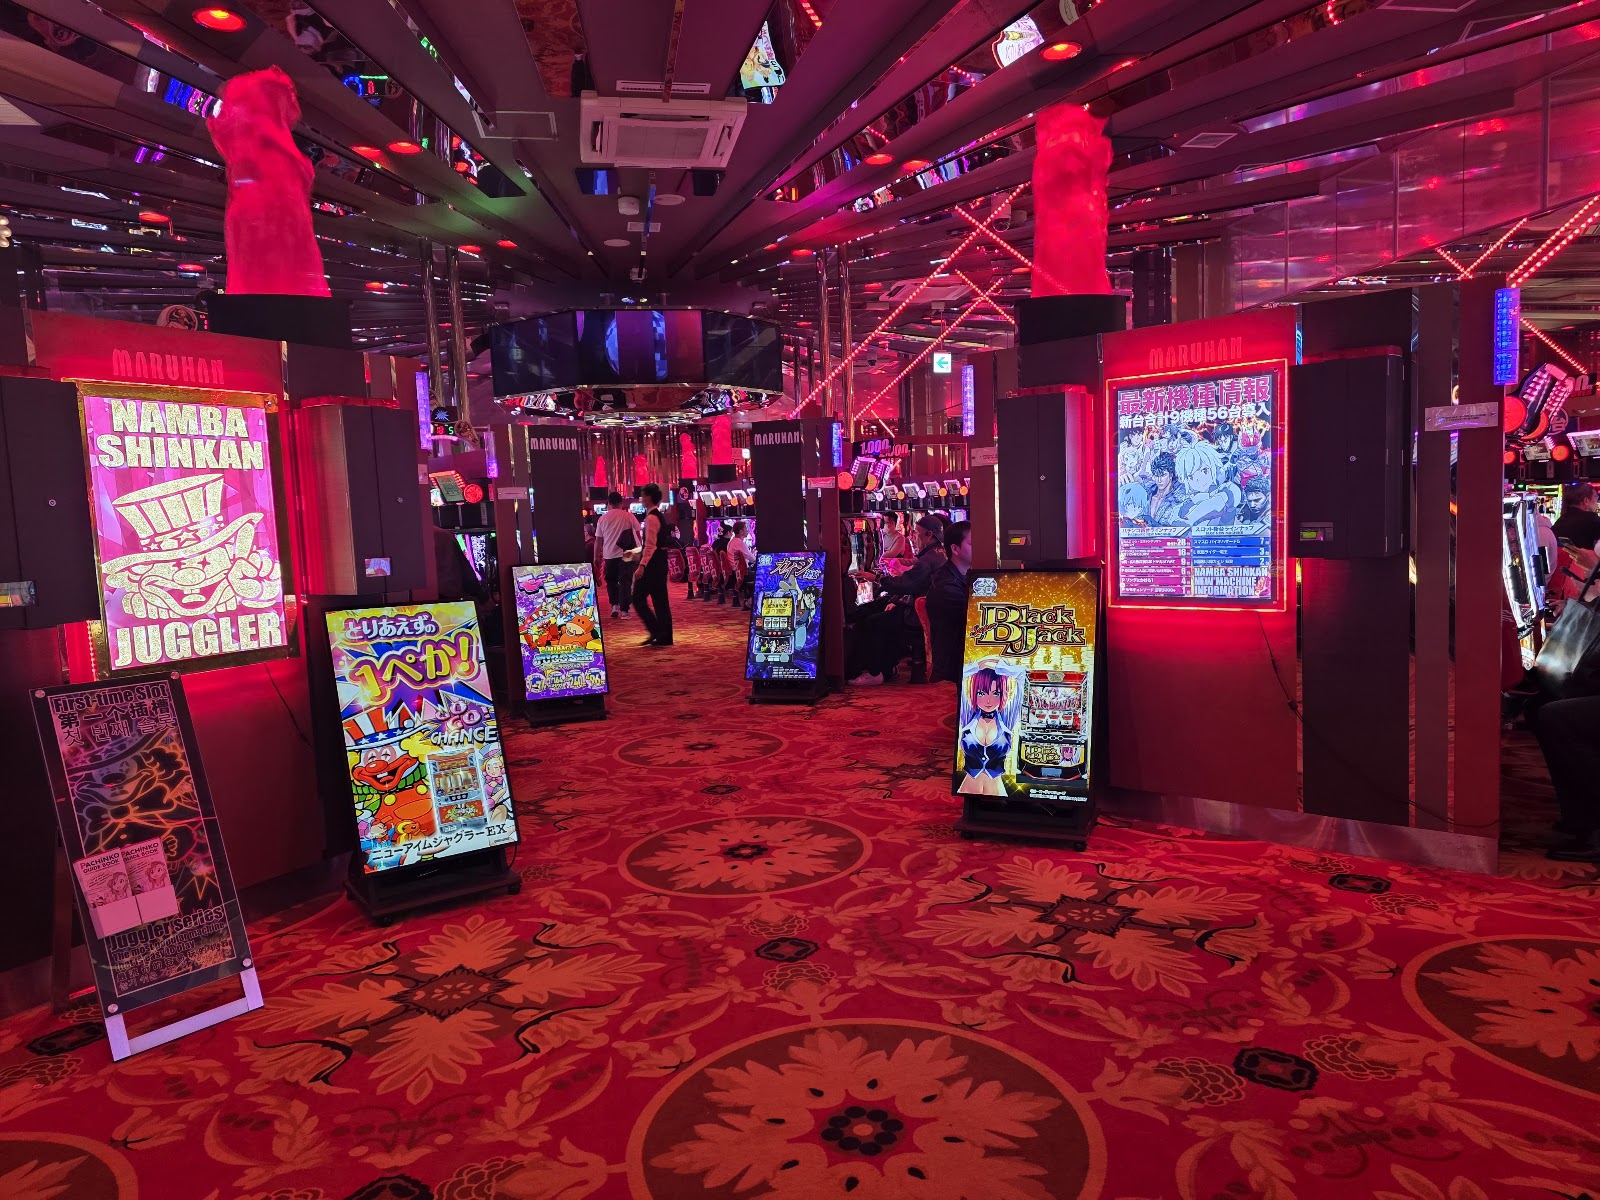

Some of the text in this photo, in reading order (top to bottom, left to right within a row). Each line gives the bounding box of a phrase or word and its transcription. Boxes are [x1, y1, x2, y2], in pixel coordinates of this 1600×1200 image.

[112, 348, 226, 385] MARUHAN
[1149, 337, 1242, 370] MARUHAN
[1119, 377, 1270, 415] 最新機種情報
[110, 398, 249, 438] NAMBA
[1119, 402, 1270, 429] 新台合計9機種56台導入
[96, 434, 264, 470] SHINKAN
[530, 437, 578, 451] MARUHAN
[753, 431, 800, 446] MARUHAN
[1194, 567, 1269, 577] NAMBA SHINKAN
[1194, 576, 1257, 586] NEW MACHINE
[1194, 585, 1255, 596] INFORMATION
[346, 614, 436, 640] とりあえずの
[980, 606, 1074, 642] Black
[1003, 625, 1085, 655] Jack
[114, 613, 282, 668] JUGGLER
[354, 635, 473, 698] 1ペか!
[53, 684, 169, 713] First-time Slot
[58, 698, 170, 730] 第一个插槽
[63, 713, 177, 747] 첫 번째 슬롯
[430, 727, 499, 746] CHANCE
[371, 823, 508, 862] ニューアイムジャグラーEX
[102, 858, 120, 869] BOOK
[109, 906, 224, 951] Juggler series
